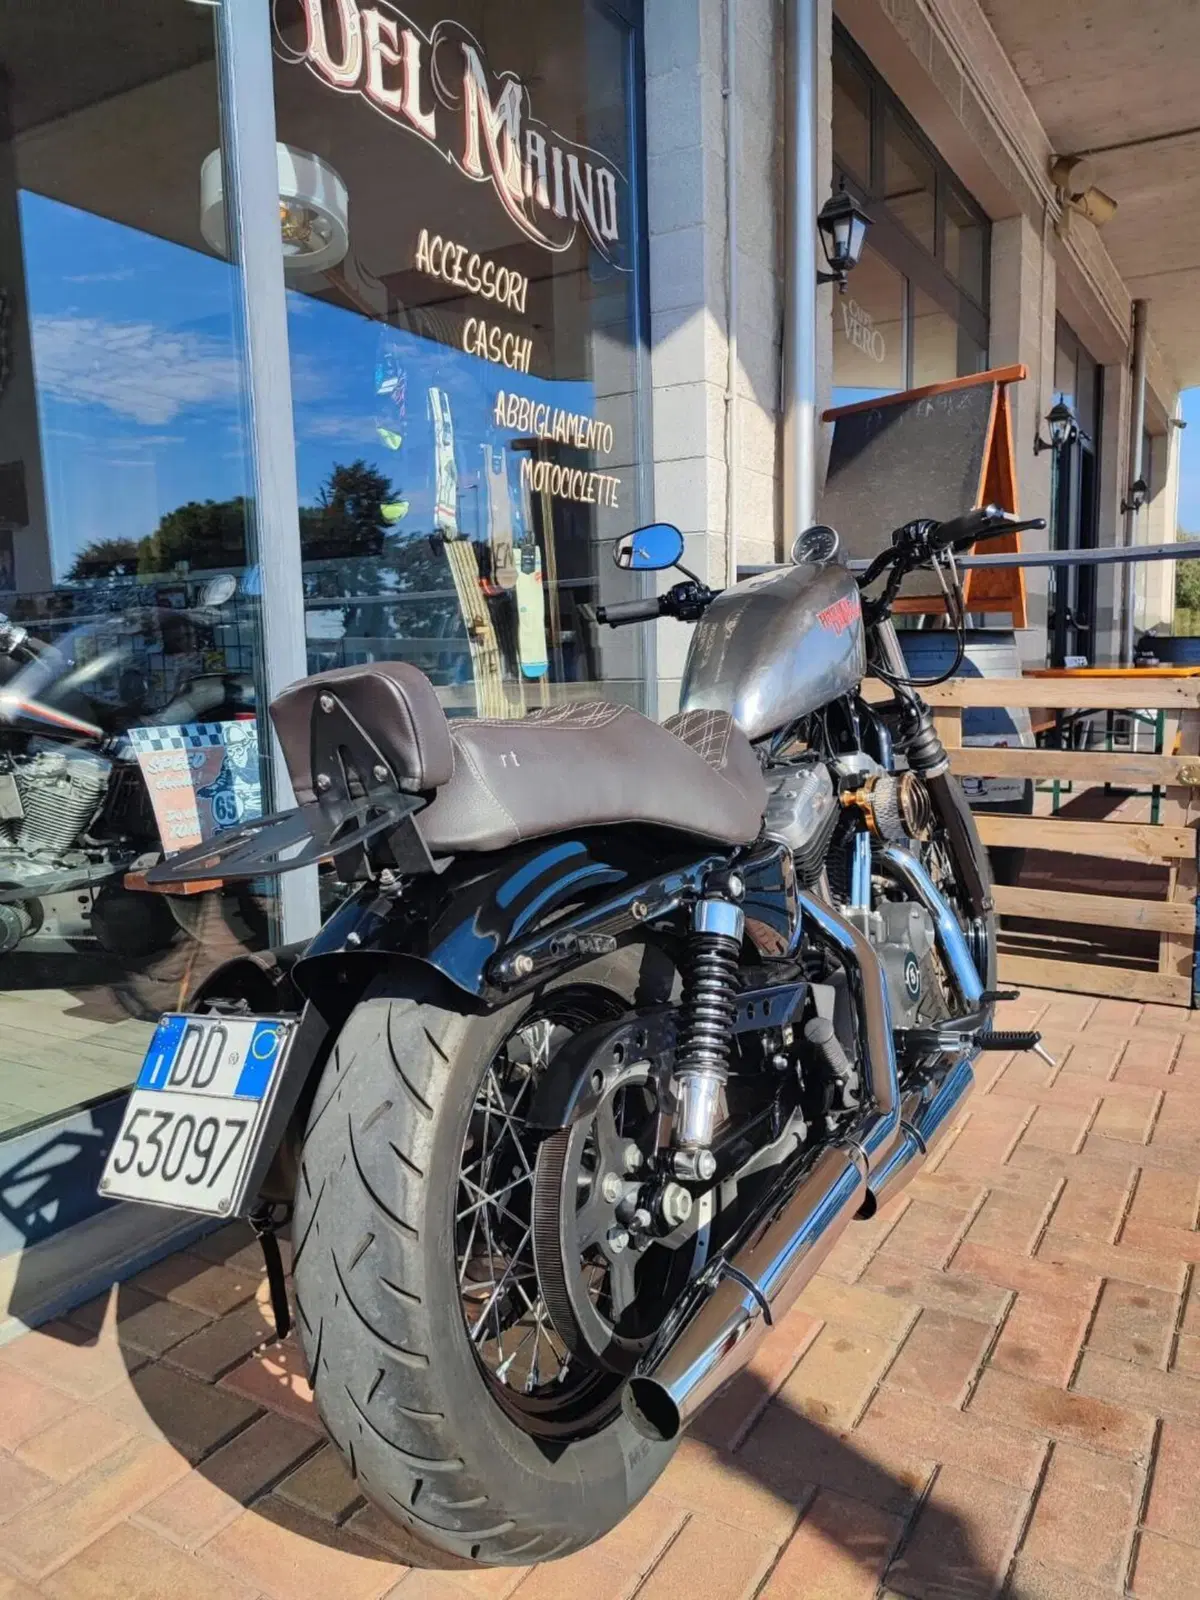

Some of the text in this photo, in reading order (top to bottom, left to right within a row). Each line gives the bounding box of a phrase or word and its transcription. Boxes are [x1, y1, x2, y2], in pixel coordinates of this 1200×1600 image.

[416, 229, 528, 313] ACCESSORI
[463, 317, 532, 374] CASCHI
[841, 301, 885, 363] VERO
[494, 390, 613, 454] ABBIGLIAMENTO
[520, 458, 621, 508] MOTOCICLETTE
[168, 1024, 228, 1088] DD
[113, 1108, 249, 1188] 53097
